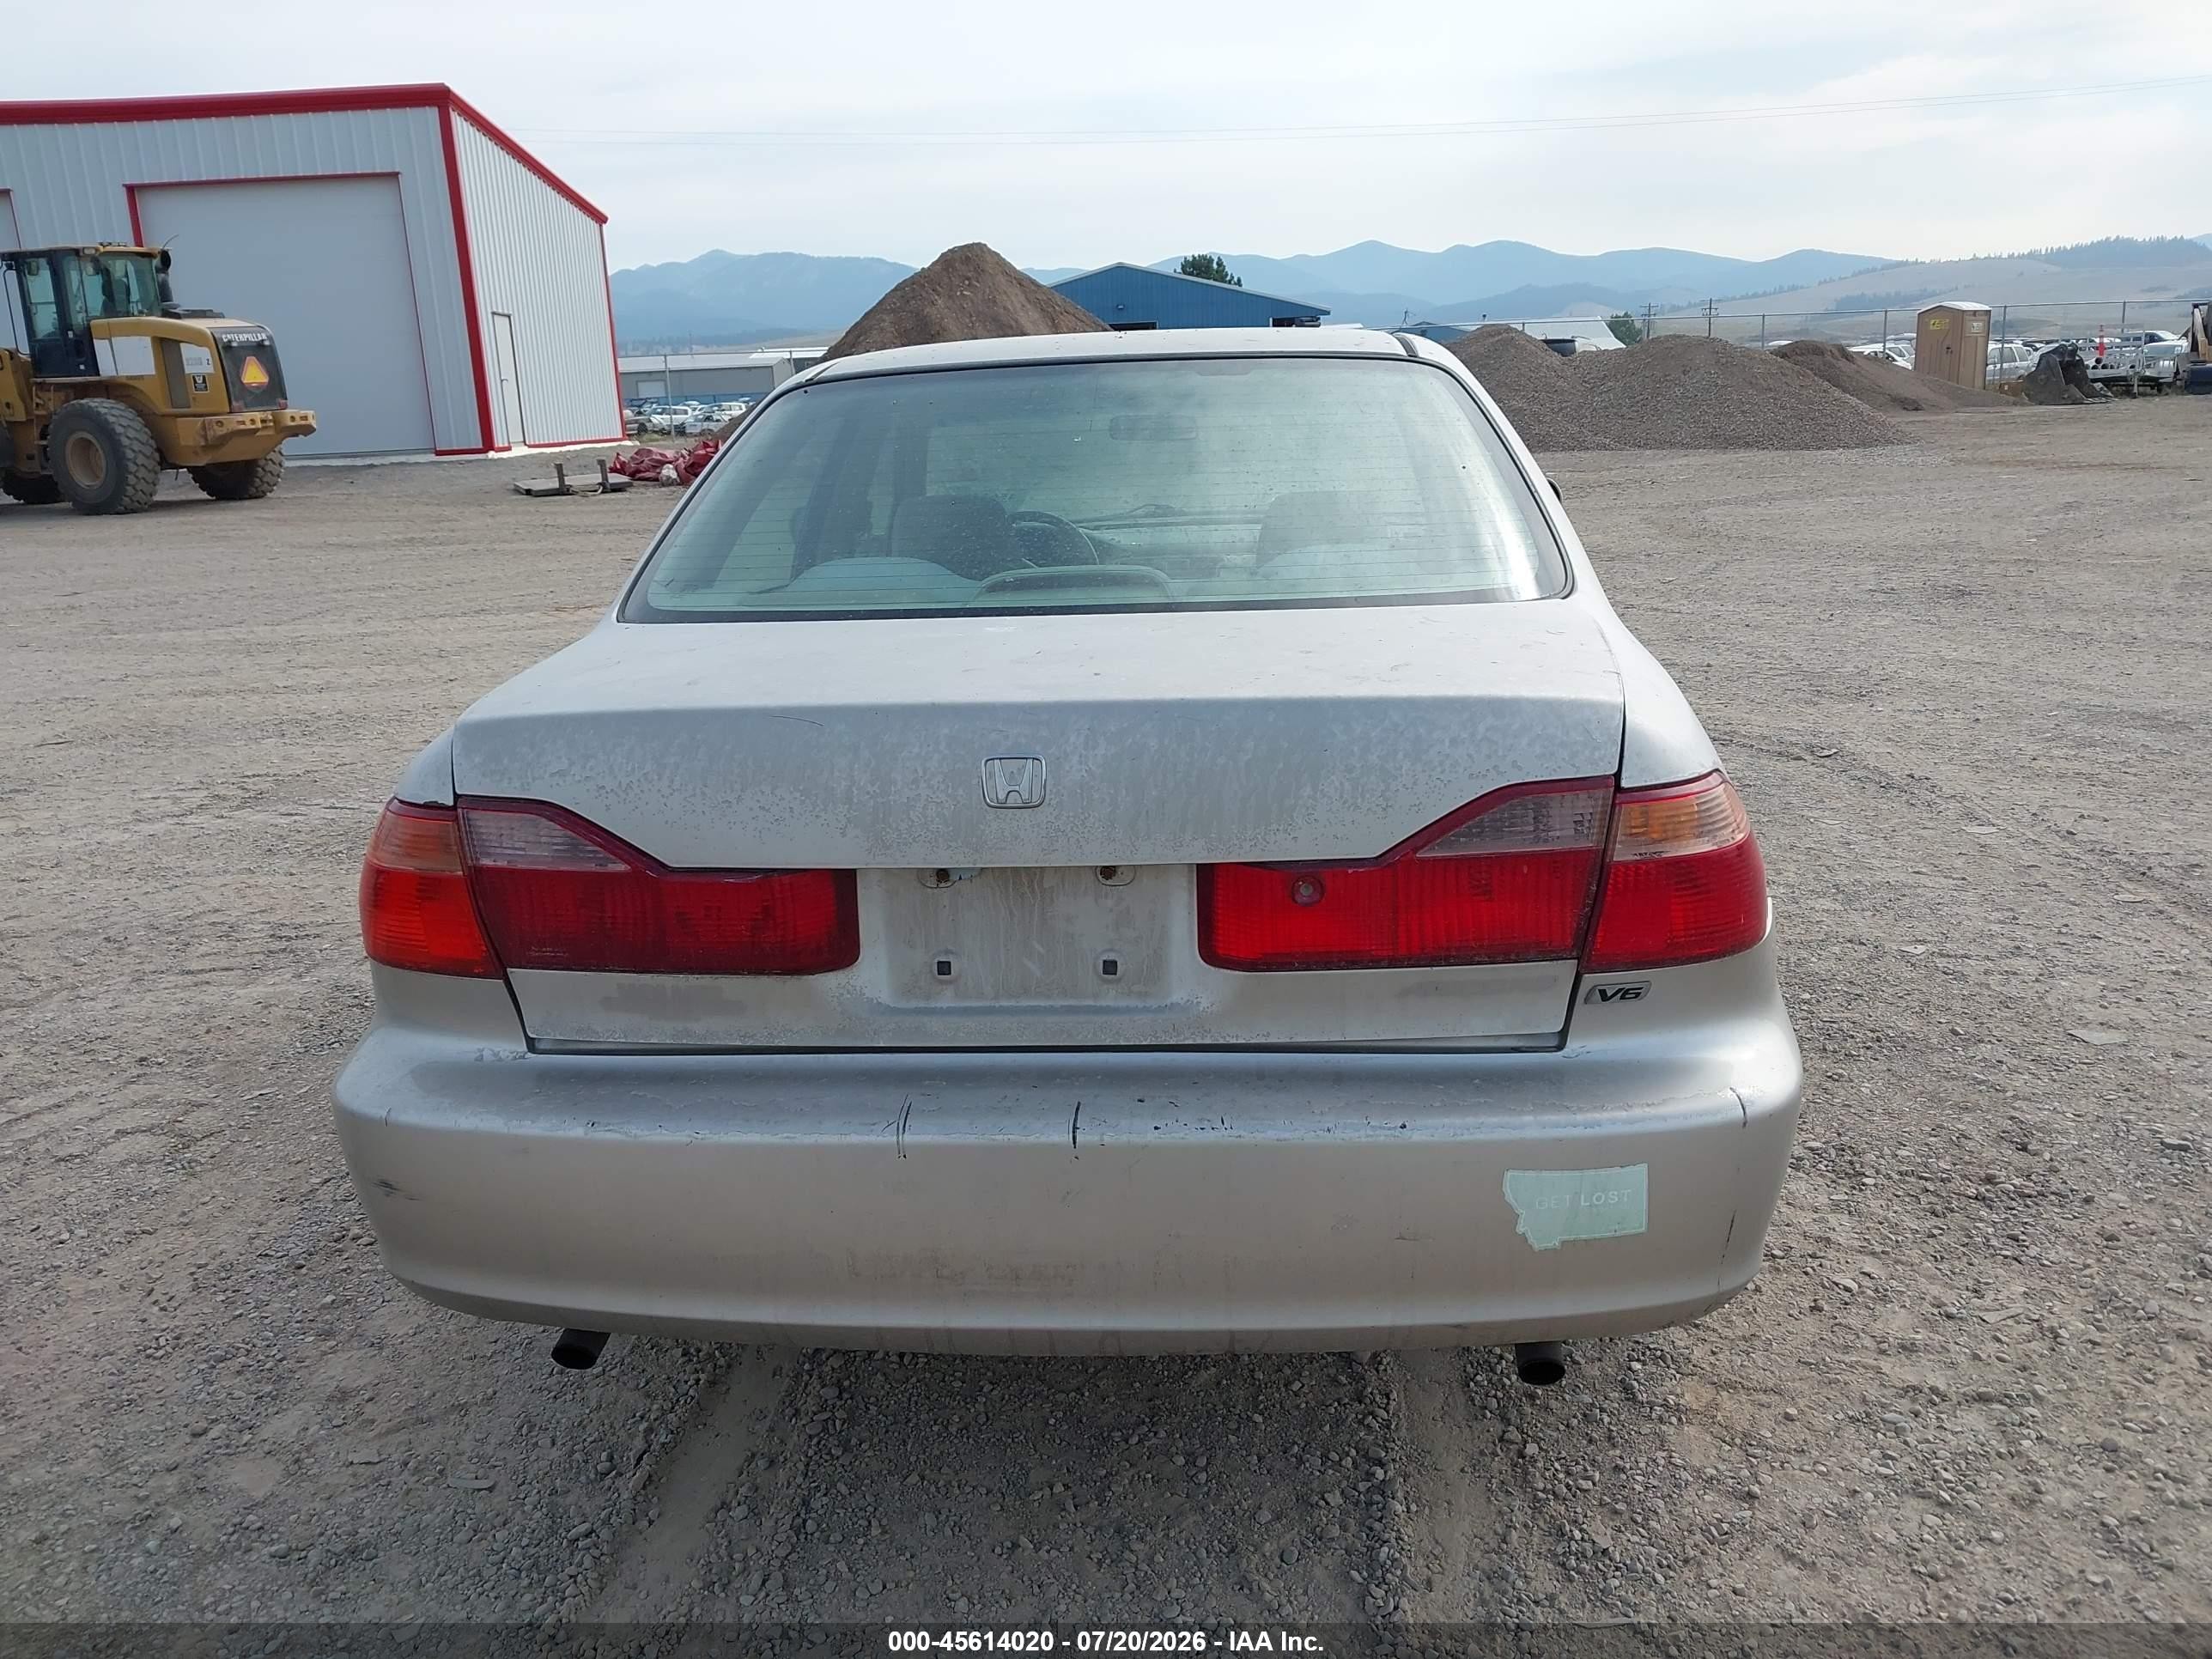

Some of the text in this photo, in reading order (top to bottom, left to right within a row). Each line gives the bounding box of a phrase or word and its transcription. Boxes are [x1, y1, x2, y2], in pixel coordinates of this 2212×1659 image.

[222, 332, 268, 343] CATERPILLAR
[1597, 987, 1644, 1002] V6
[1535, 1188, 1632, 1210] GET LOST
